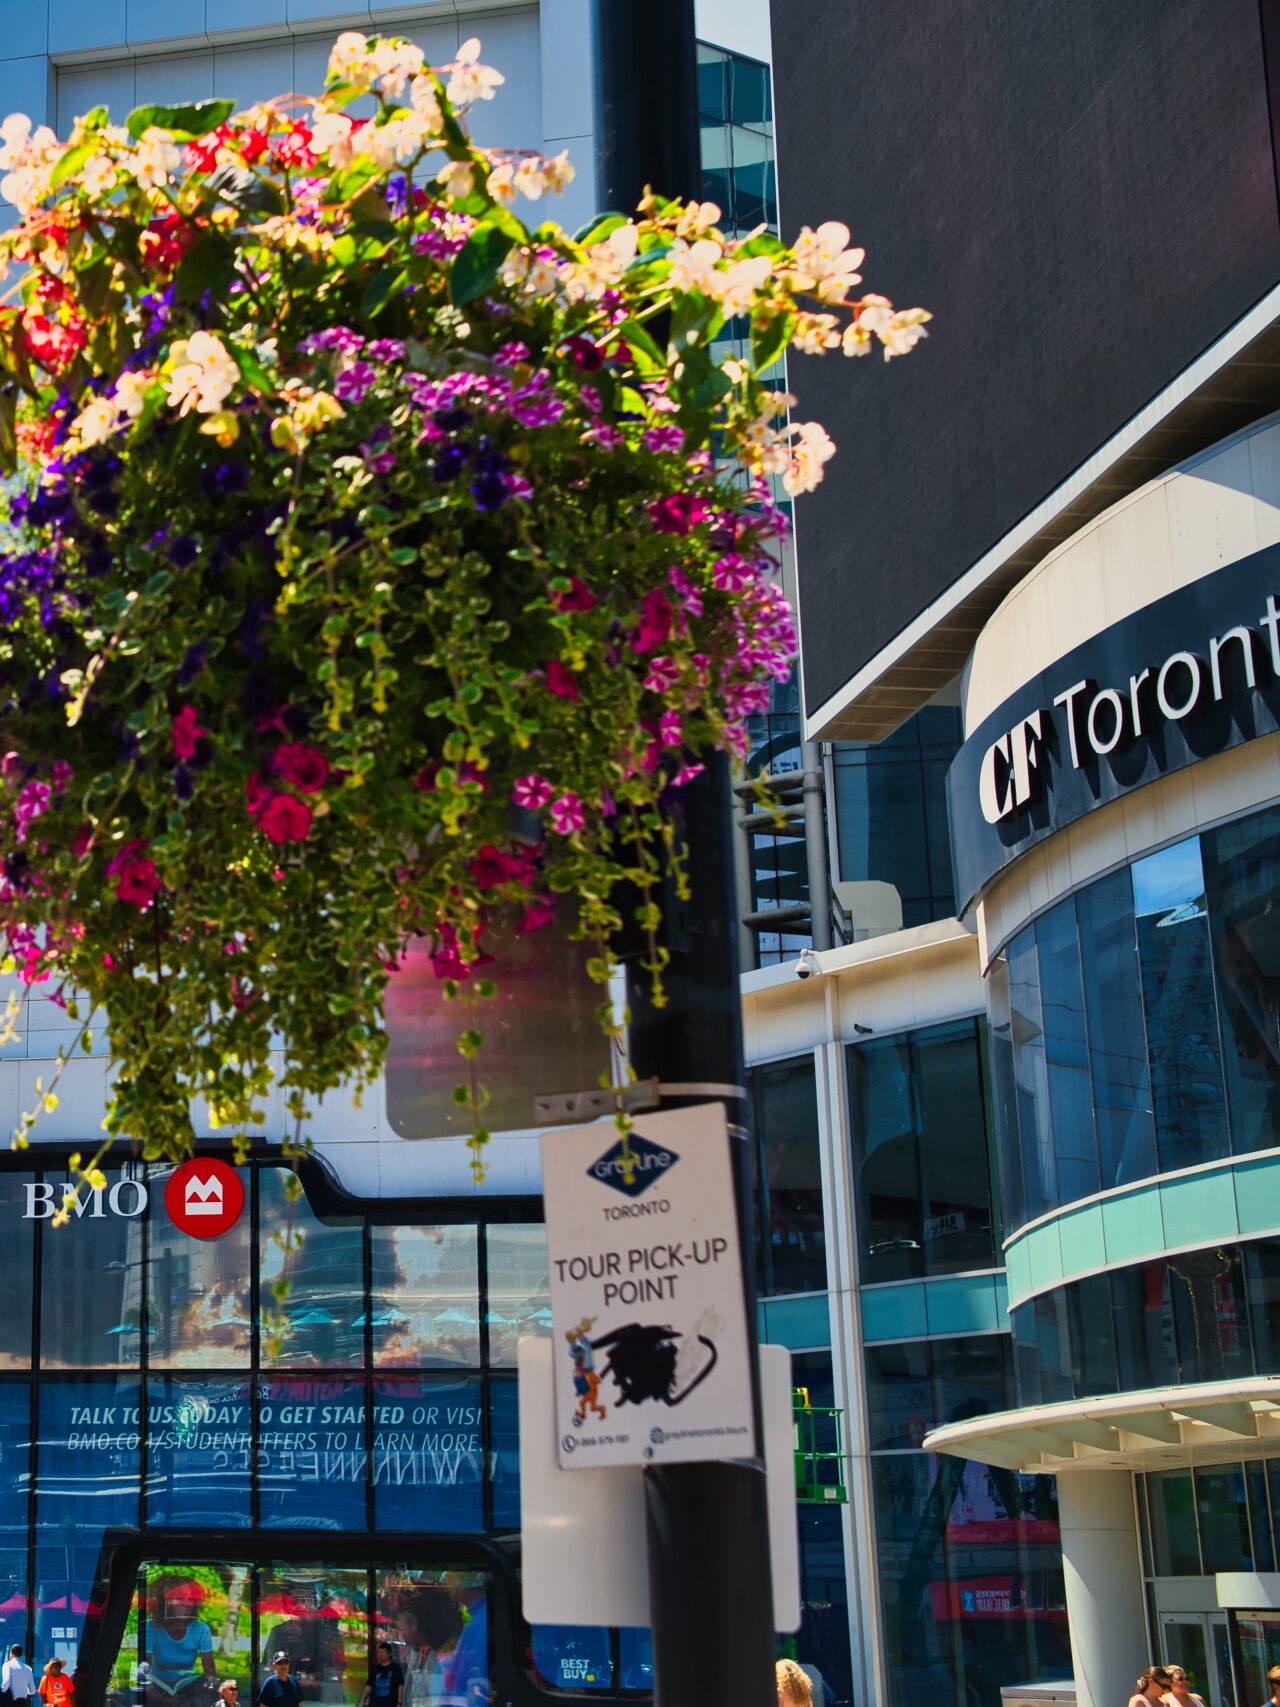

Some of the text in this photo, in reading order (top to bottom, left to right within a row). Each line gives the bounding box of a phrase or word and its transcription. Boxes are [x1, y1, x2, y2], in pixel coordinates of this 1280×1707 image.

[979, 594, 1280, 824] CF Toront
[21, 1180, 148, 1219] BMO
[602, 1198, 671, 1221] TORONTO
[554, 1237, 729, 1283] TOUR PICK-UP
[603, 1275, 679, 1307] POINT
[71, 1406, 116, 1425] TALK
[177, 1406, 243, 1425] ODAY
[280, 1406, 316, 1425] GET
[412, 1407, 438, 1425] OR
[446, 1407, 494, 1425] VISI
[325, 1432, 348, 1450] TO
[354, 1432, 415, 1451] LARN
[421, 1433, 483, 1452] MORE.
[561, 1659, 589, 1669] BEST
[563, 1669, 587, 1679] BUY
